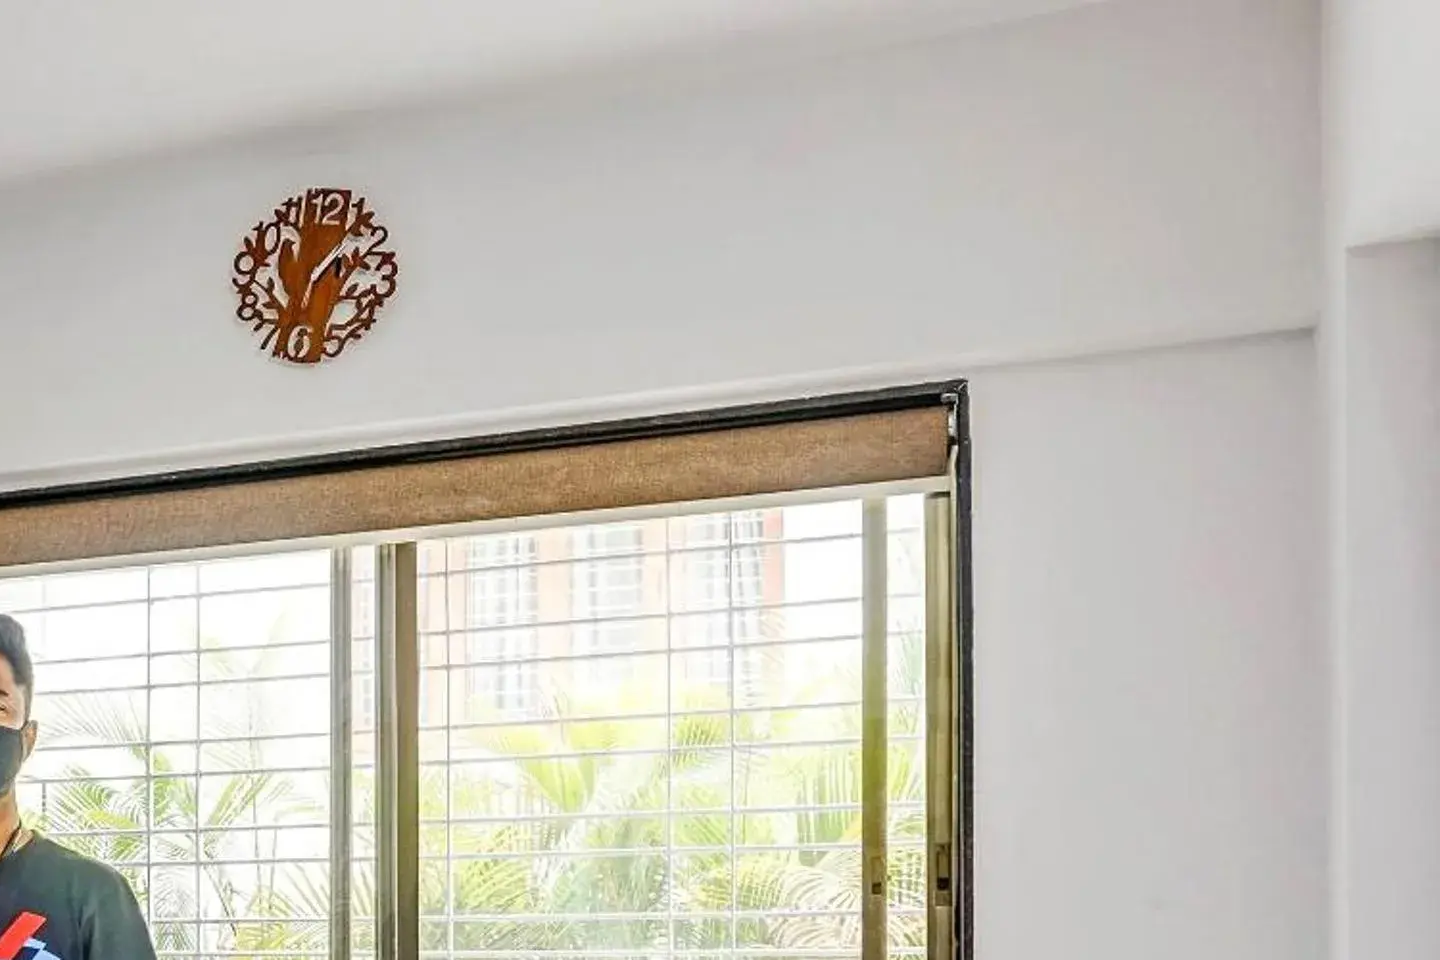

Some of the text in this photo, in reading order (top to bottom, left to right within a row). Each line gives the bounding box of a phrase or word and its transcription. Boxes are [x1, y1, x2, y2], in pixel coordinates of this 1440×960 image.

[310, 192, 346, 226] 12
[251, 221, 281, 256] 10
[363, 225, 392, 258] 2
[232, 250, 258, 289] 9
[374, 252, 399, 299] 3
[236, 293, 261, 321] 8
[253, 317, 280, 351] 7
[287, 325, 312, 359] 6
[323, 324, 349, 358] 5
